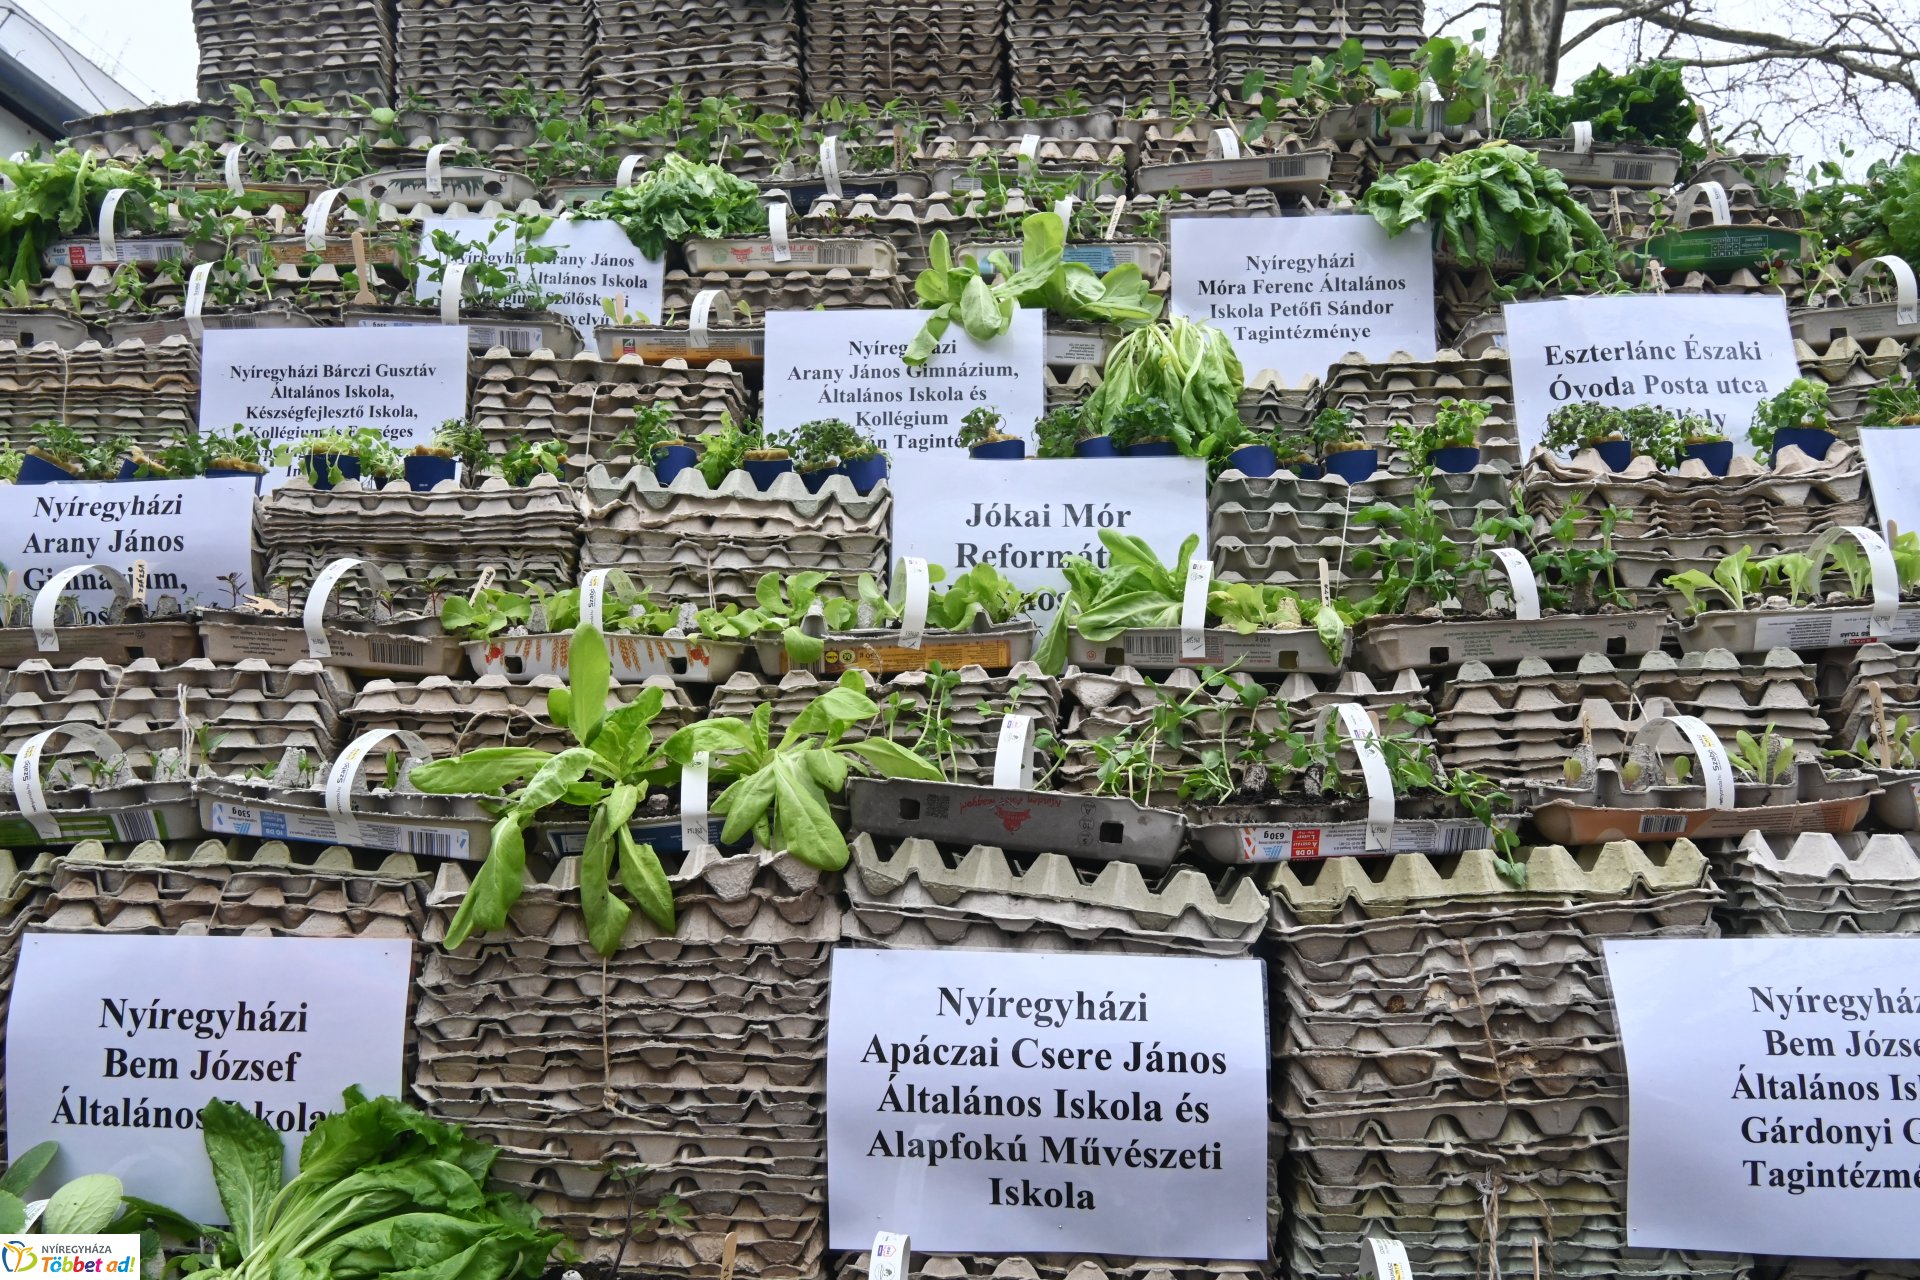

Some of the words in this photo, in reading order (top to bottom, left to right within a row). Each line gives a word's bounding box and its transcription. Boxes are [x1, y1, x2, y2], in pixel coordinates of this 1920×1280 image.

[452, 250, 526, 267] yíregyhá
[545, 253, 586, 267] rany
[591, 252, 635, 267] János
[1246, 252, 1355, 274] Nyíregyházi
[602, 273, 648, 289] Iskola
[1198, 279, 1246, 296] Móra
[1252, 279, 1314, 295] Ferenc
[1319, 273, 1406, 292] Általános
[1210, 303, 1263, 319] Iskola
[1270, 301, 1322, 317] Petőfi
[1327, 300, 1394, 316] Sándor
[1234, 323, 1371, 343] Tagintézménye
[848, 340, 957, 358] Nyíregázi
[1544, 339, 1676, 366] Eszterlánc
[1683, 334, 1763, 360] Északi
[230, 364, 318, 382] Nyíregyházi
[322, 364, 371, 378] Bárczi
[375, 363, 436, 377] Gusztáv
[787, 366, 844, 383] Arany
[849, 364, 900, 380] János
[906, 362, 1019, 380] Gimnázium,
[271, 382, 340, 399] Általános
[345, 385, 395, 400] Iskola,
[818, 384, 903, 404] Általános
[909, 387, 964, 402] Iskola
[969, 386, 987, 401] és
[1549, 374, 1635, 401] Óvoda
[1643, 374, 1708, 395] Posta
[1717, 376, 1768, 394] utca
[246, 405, 364, 422] Készségfejlesztő
[369, 405, 418, 420] Iskola,
[855, 410, 949, 429] Kollégium
[249, 426, 323, 441] Kollégium
[33, 494, 183, 522] Nyíregyházi
[965, 503, 1050, 528] Jókai
[1062, 503, 1131, 528] Mór
[22, 532, 100, 558] Arany
[108, 529, 185, 552] János
[955, 542, 1108, 569] Reformát
[936, 986, 1148, 1028] Nyíregyházi
[1748, 986, 1920, 1021] Nyíregyhá
[99, 998, 308, 1039] Nyíregyházi
[860, 1033, 1000, 1073] Apáczai
[1011, 1037, 1112, 1070] Csere
[1123, 1041, 1227, 1075] János
[1762, 1029, 1836, 1056] Bem
[102, 1047, 178, 1079] Bem
[190, 1050, 302, 1082] József
[1731, 1064, 1879, 1101] Általános
[1888, 1074, 1920, 1101] Is
[877, 1073, 1041, 1117] Általános
[1053, 1088, 1163, 1122] Iskola
[1175, 1092, 1210, 1124] és
[223, 1100, 327, 1132] kola
[1741, 1116, 1893, 1151] Gárdonyi
[867, 1130, 1027, 1166] Alapfokú
[1040, 1135, 1222, 1170] Művészeti
[988, 1177, 1096, 1210] Iskola
